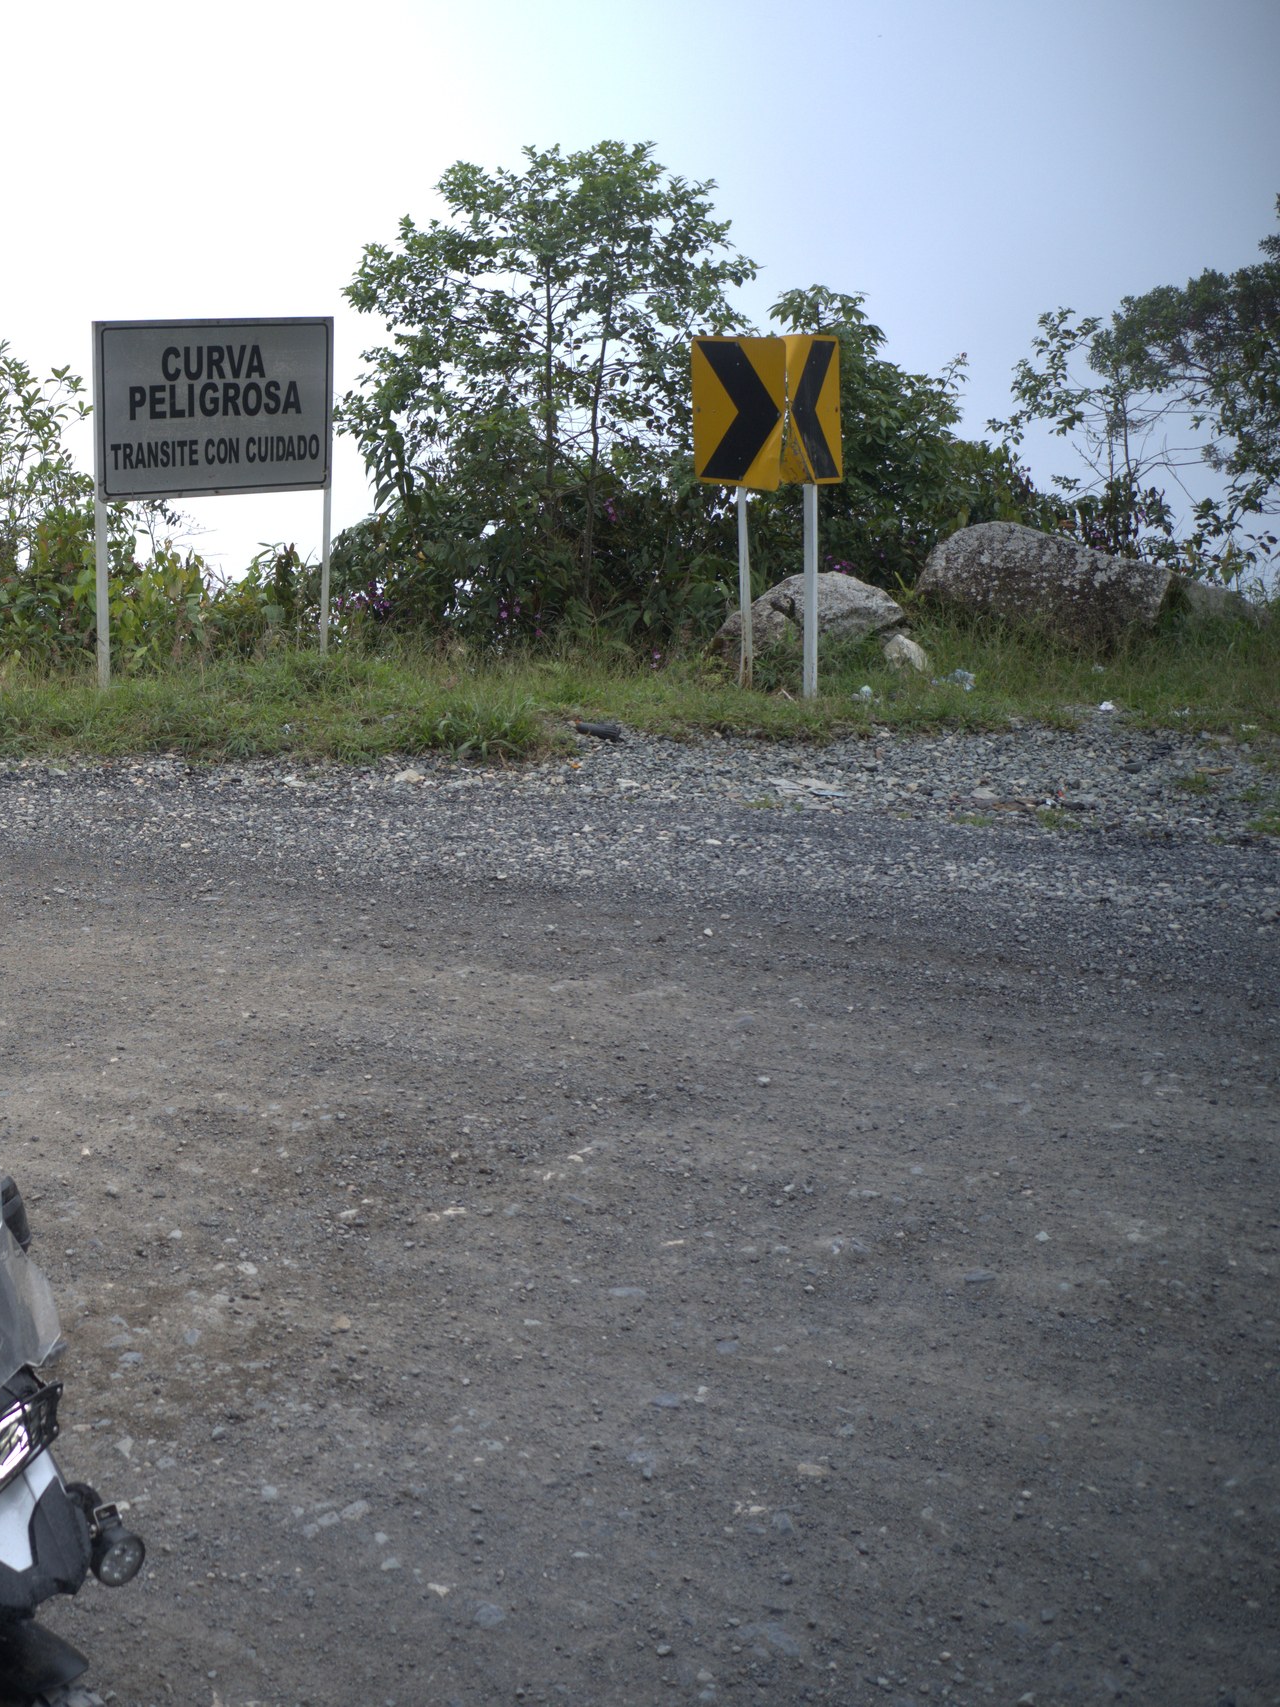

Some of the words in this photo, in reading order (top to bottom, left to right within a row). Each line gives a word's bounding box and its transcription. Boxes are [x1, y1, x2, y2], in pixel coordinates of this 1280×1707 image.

[161, 344, 266, 382] CURVA
[129, 380, 302, 421] PELIGROSA
[110, 439, 199, 470] TRANSITE
[204, 437, 240, 465] CON
[245, 434, 320, 463] CUIDADO
